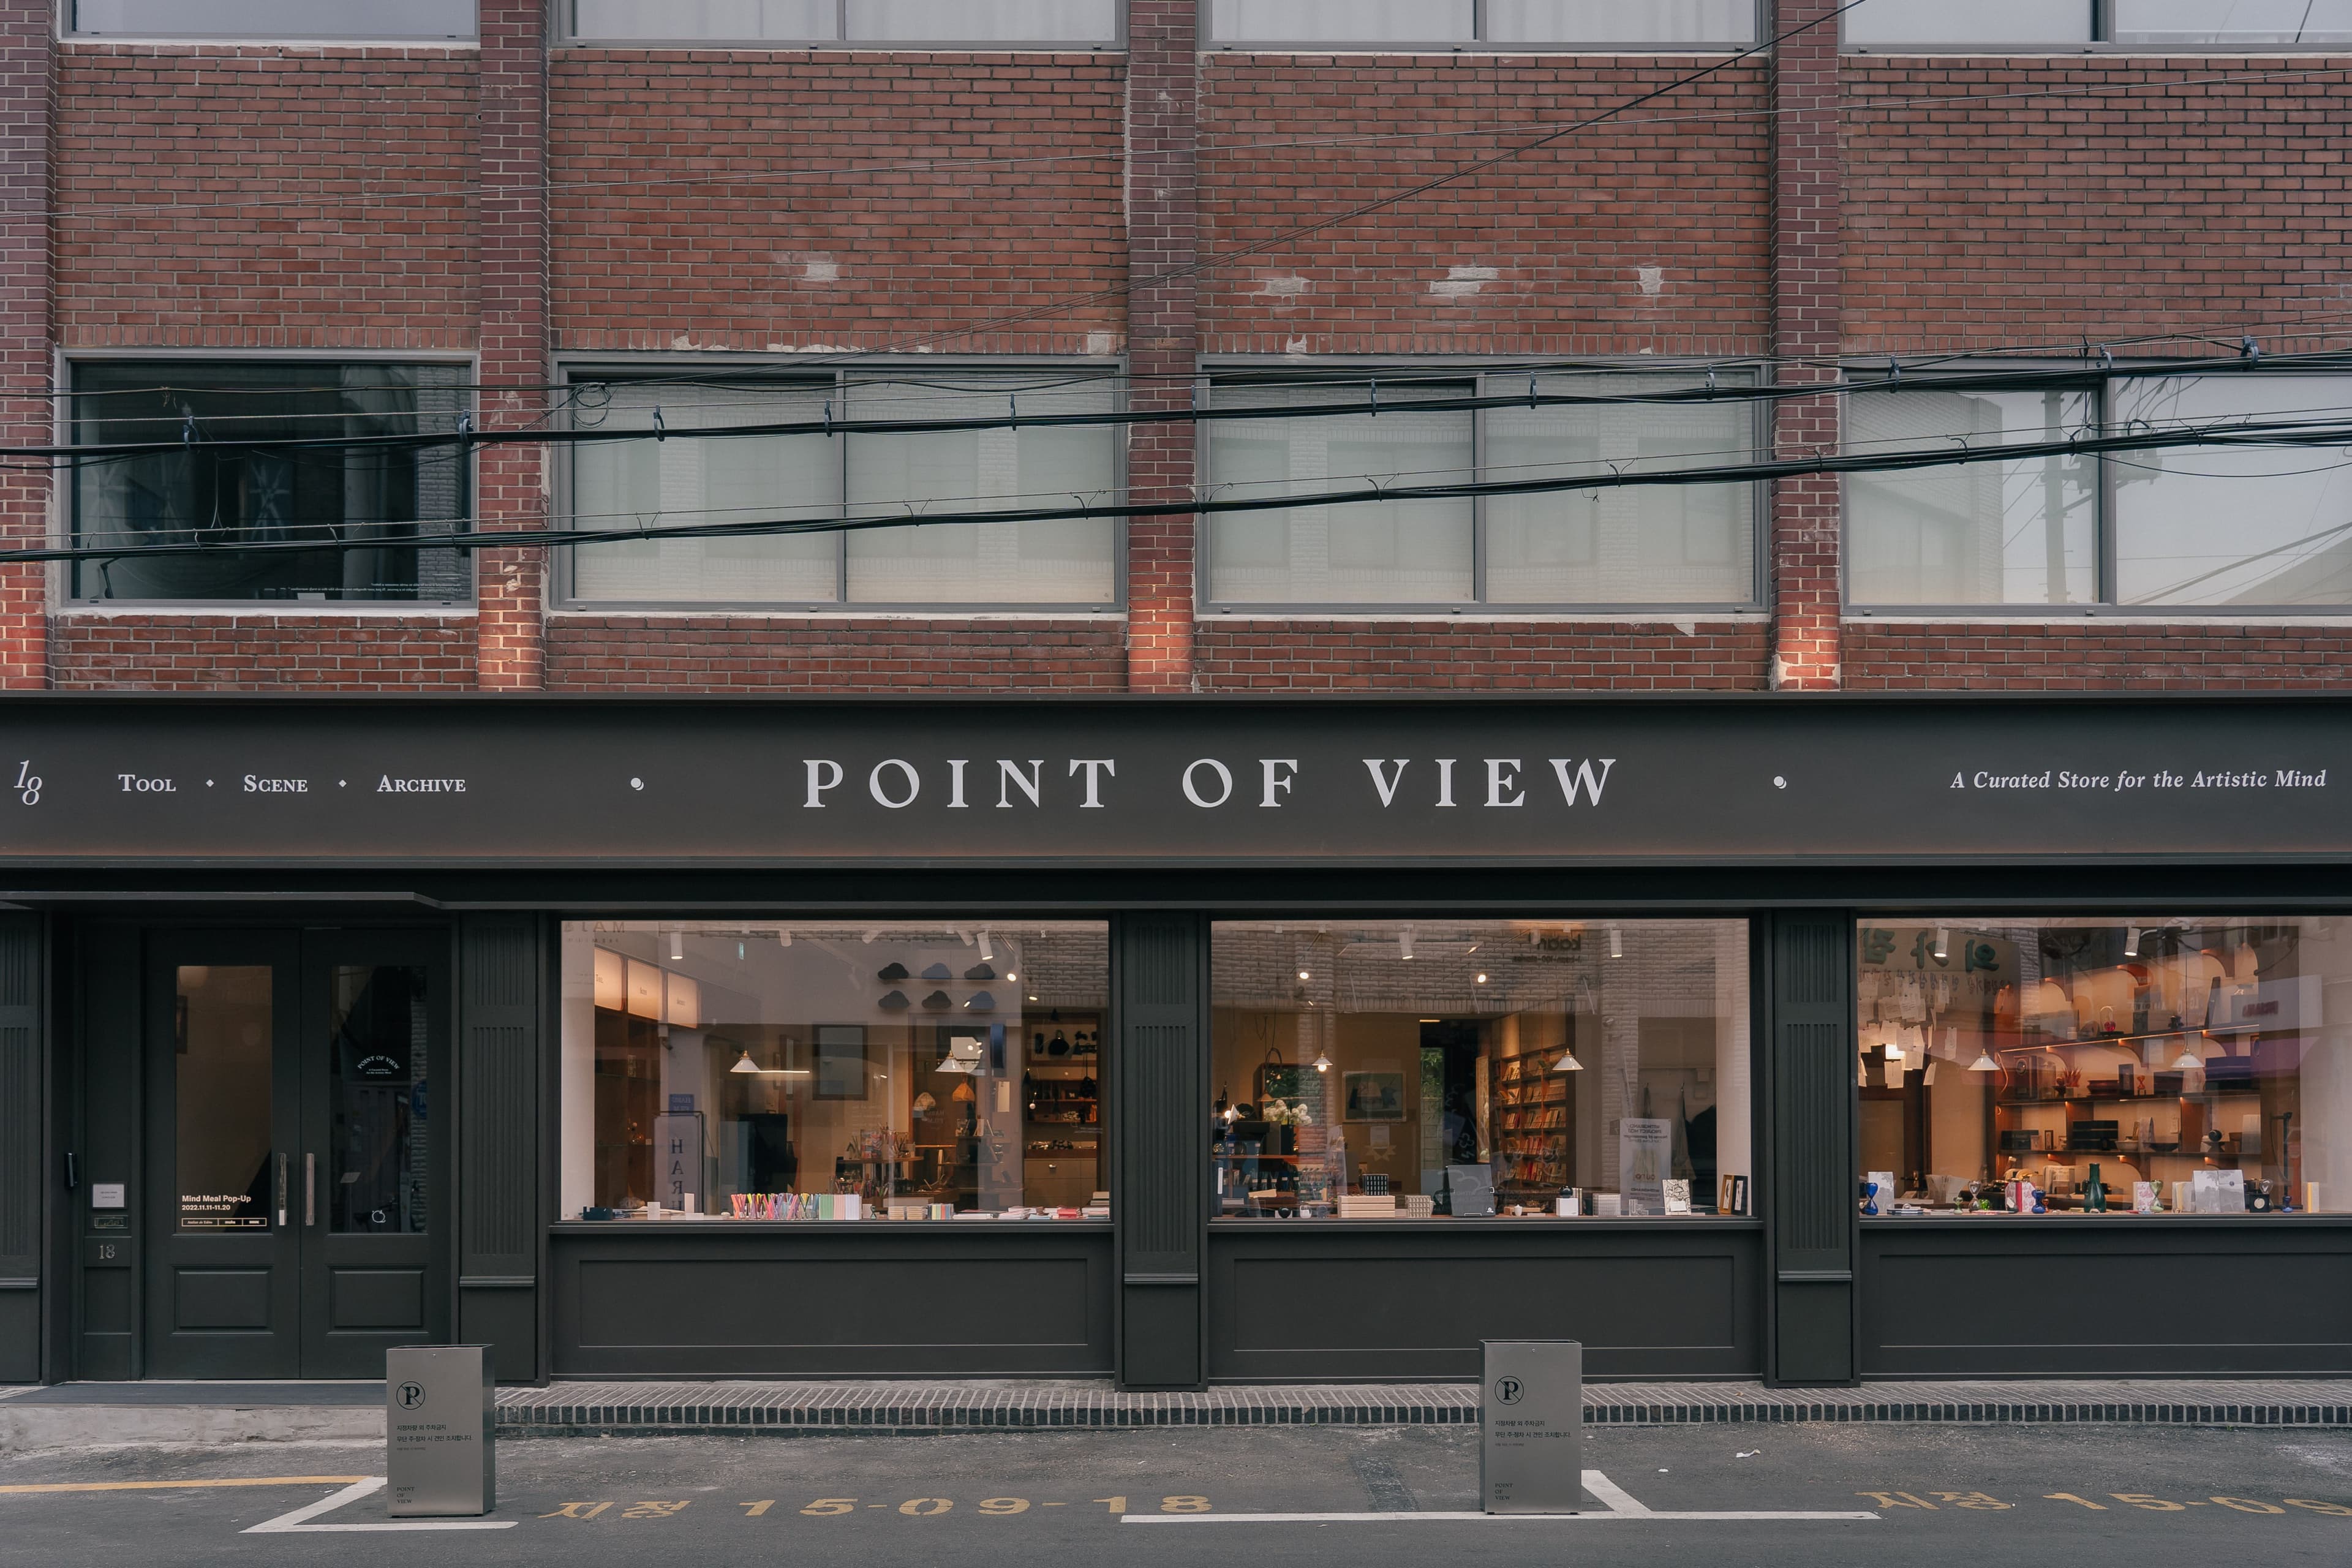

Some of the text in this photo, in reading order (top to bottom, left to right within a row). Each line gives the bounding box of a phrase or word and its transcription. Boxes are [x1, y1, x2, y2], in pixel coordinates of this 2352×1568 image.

[802, 758, 1616, 809] POINT OF VIEW
[1950, 769, 2326, 792] A Curated Store for the Artistic Mind
[357, 1056, 375, 1069] POINT
[385, 1057, 400, 1069] VIEW
[223, 1195, 251, 1204] Pop-Up
[99, 1244, 115, 1259] 18
[538, 1500, 692, 1518] 지정
[1855, 1491, 2011, 1510] 지정
